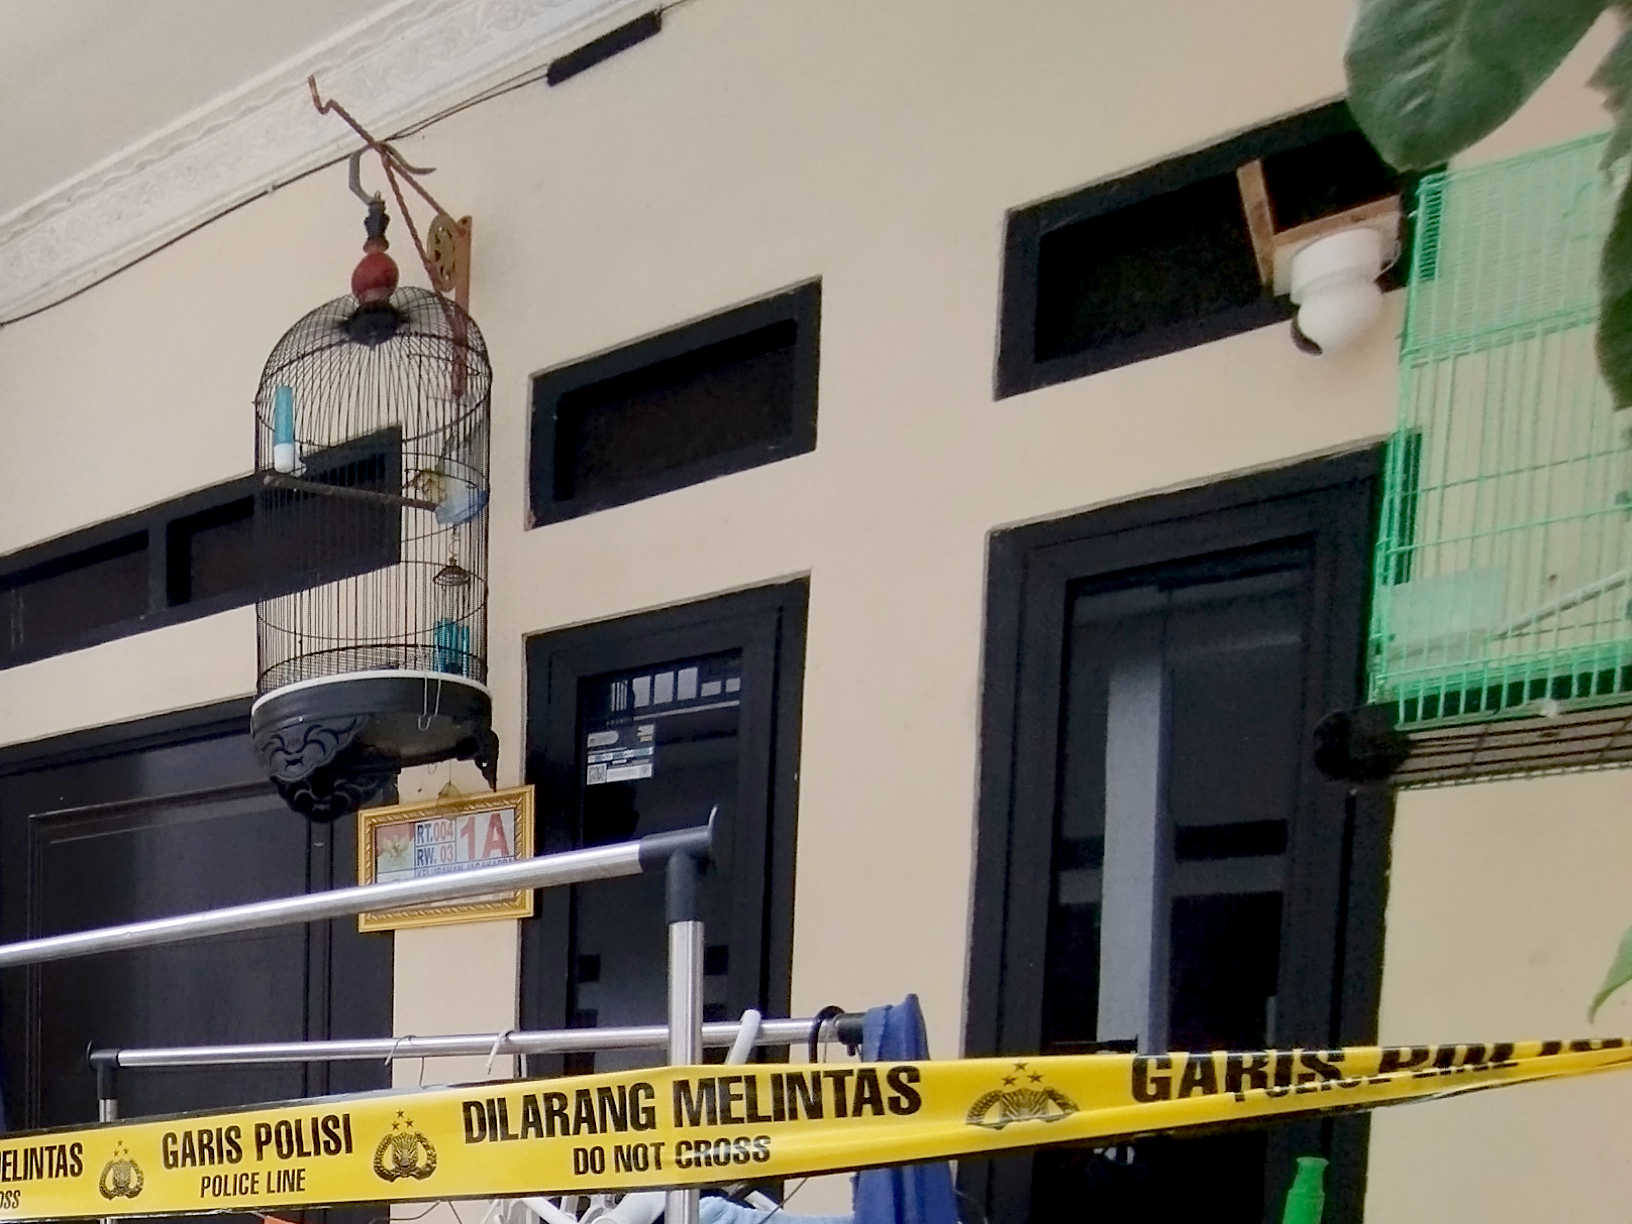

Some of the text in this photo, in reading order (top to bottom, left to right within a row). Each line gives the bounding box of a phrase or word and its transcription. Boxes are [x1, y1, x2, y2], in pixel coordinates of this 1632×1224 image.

[459, 812, 510, 860] 1A
[462, 1065, 923, 1145] DILARANG MELINTAS
[160, 1112, 354, 1170] GARIS POLISI
[572, 1135, 772, 1176] DO NOT CROSS
[199, 1168, 307, 1199] POLICE LINE
